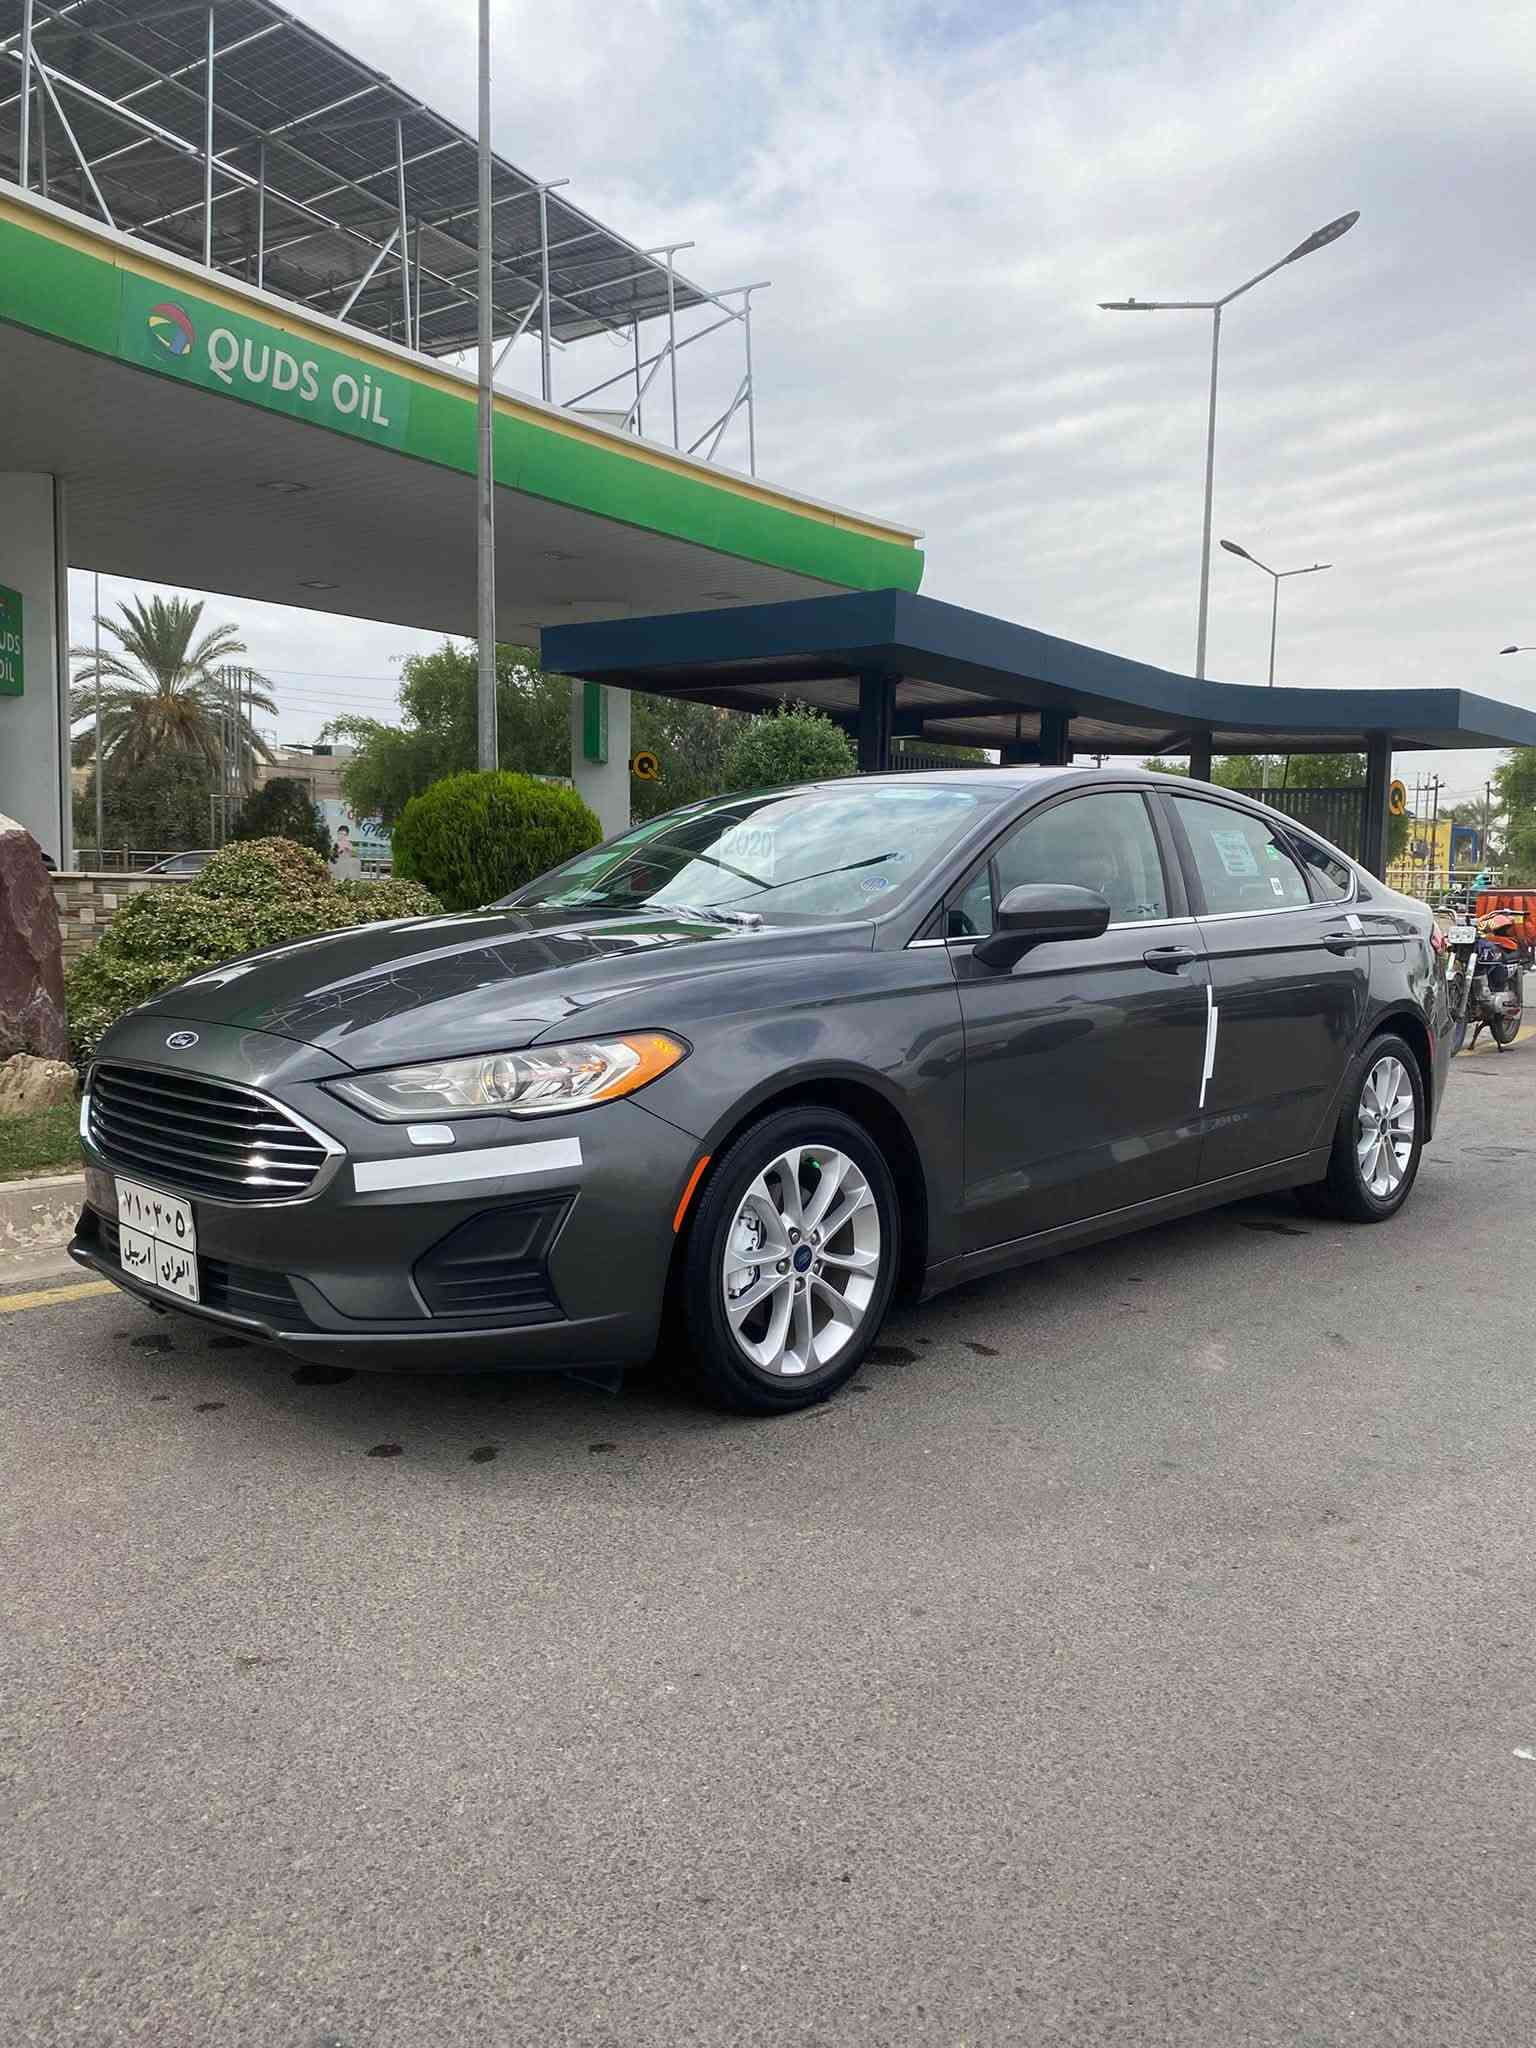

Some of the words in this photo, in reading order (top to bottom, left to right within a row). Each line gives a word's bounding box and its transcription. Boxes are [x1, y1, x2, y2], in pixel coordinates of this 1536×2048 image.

[208, 328, 319, 401] QUDS
[332, 374, 389, 426] OiL
[0, 631, 20, 655] UDS
[723, 830, 772, 858] 2020
